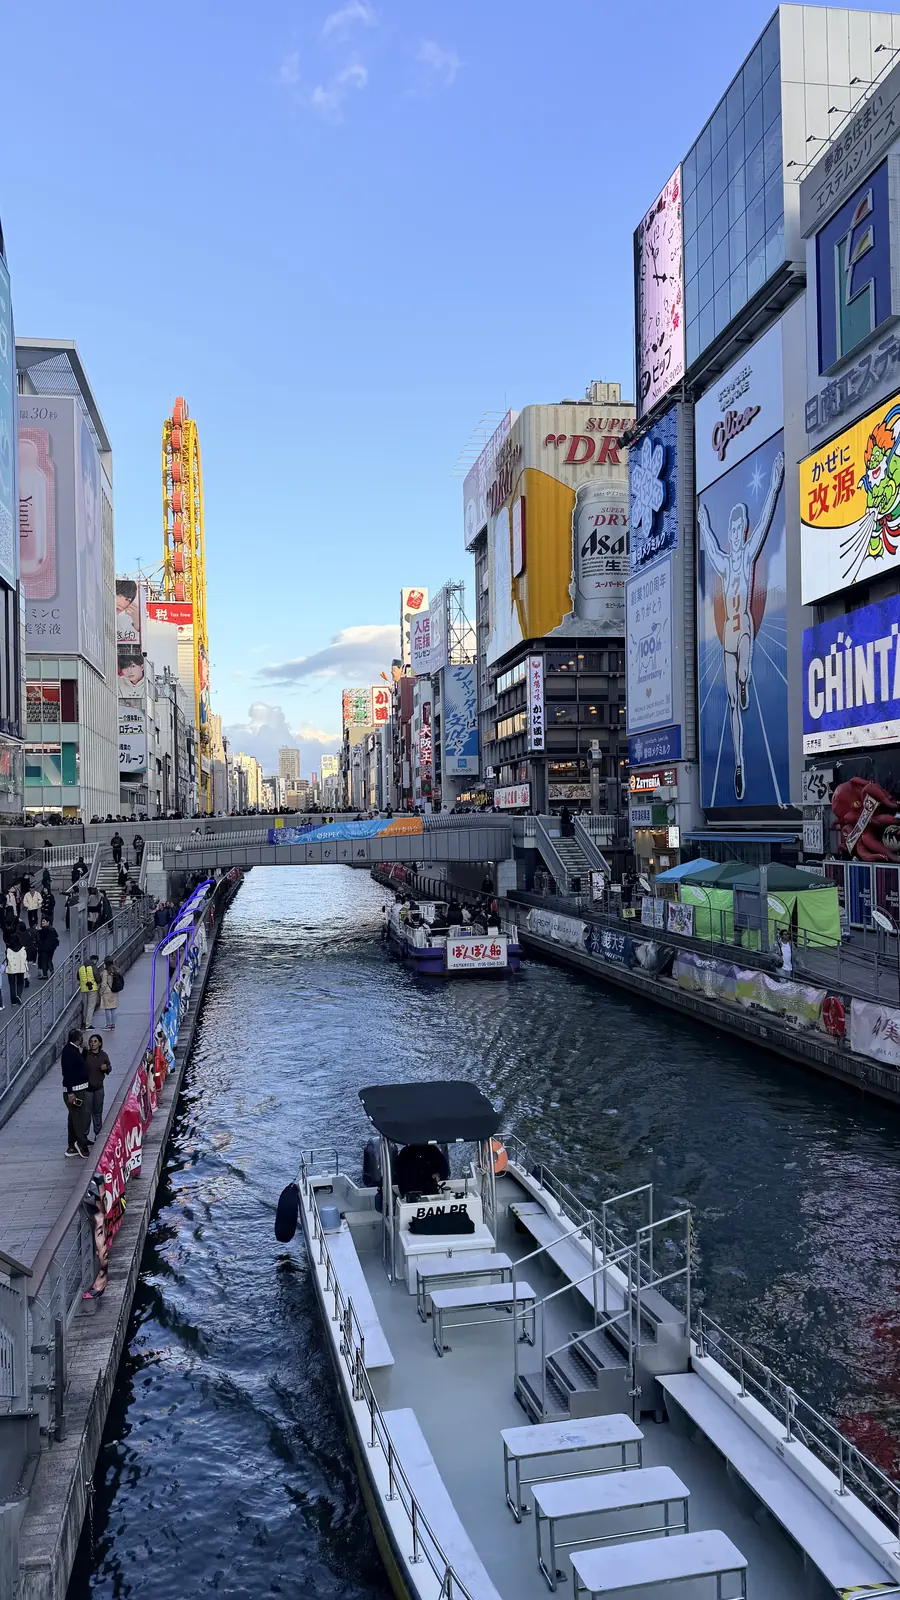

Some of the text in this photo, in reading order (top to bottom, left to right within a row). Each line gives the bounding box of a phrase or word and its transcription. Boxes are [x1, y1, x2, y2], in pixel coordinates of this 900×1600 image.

[824, 95, 883, 176] 夢ある住まい
[816, 105, 895, 213] エステムシリーズ
[652, 344, 673, 384] ピップ
[804, 334, 900, 434] 日商エステ
[712, 405, 761, 461] Glico
[811, 444, 851, 483] かぜに
[808, 462, 857, 521] 改源
[19, 495, 33, 538] Yunth
[605, 560, 621, 572] 生
[26, 607, 60, 619] ミンC
[635, 597, 662, 623] ありがとう
[731, 574, 743, 632] グリコ
[414, 618, 430, 636] 入店
[414, 634, 431, 650] 応援
[452, 666, 477, 729] シャッターは
[532, 671, 541, 702] 本場の味
[119, 752, 145, 765] グループ
[635, 777, 660, 789] ZETTERIA
[307, 848, 366, 859] えびす橋
[452, 943, 502, 960] ぽんぽん船
